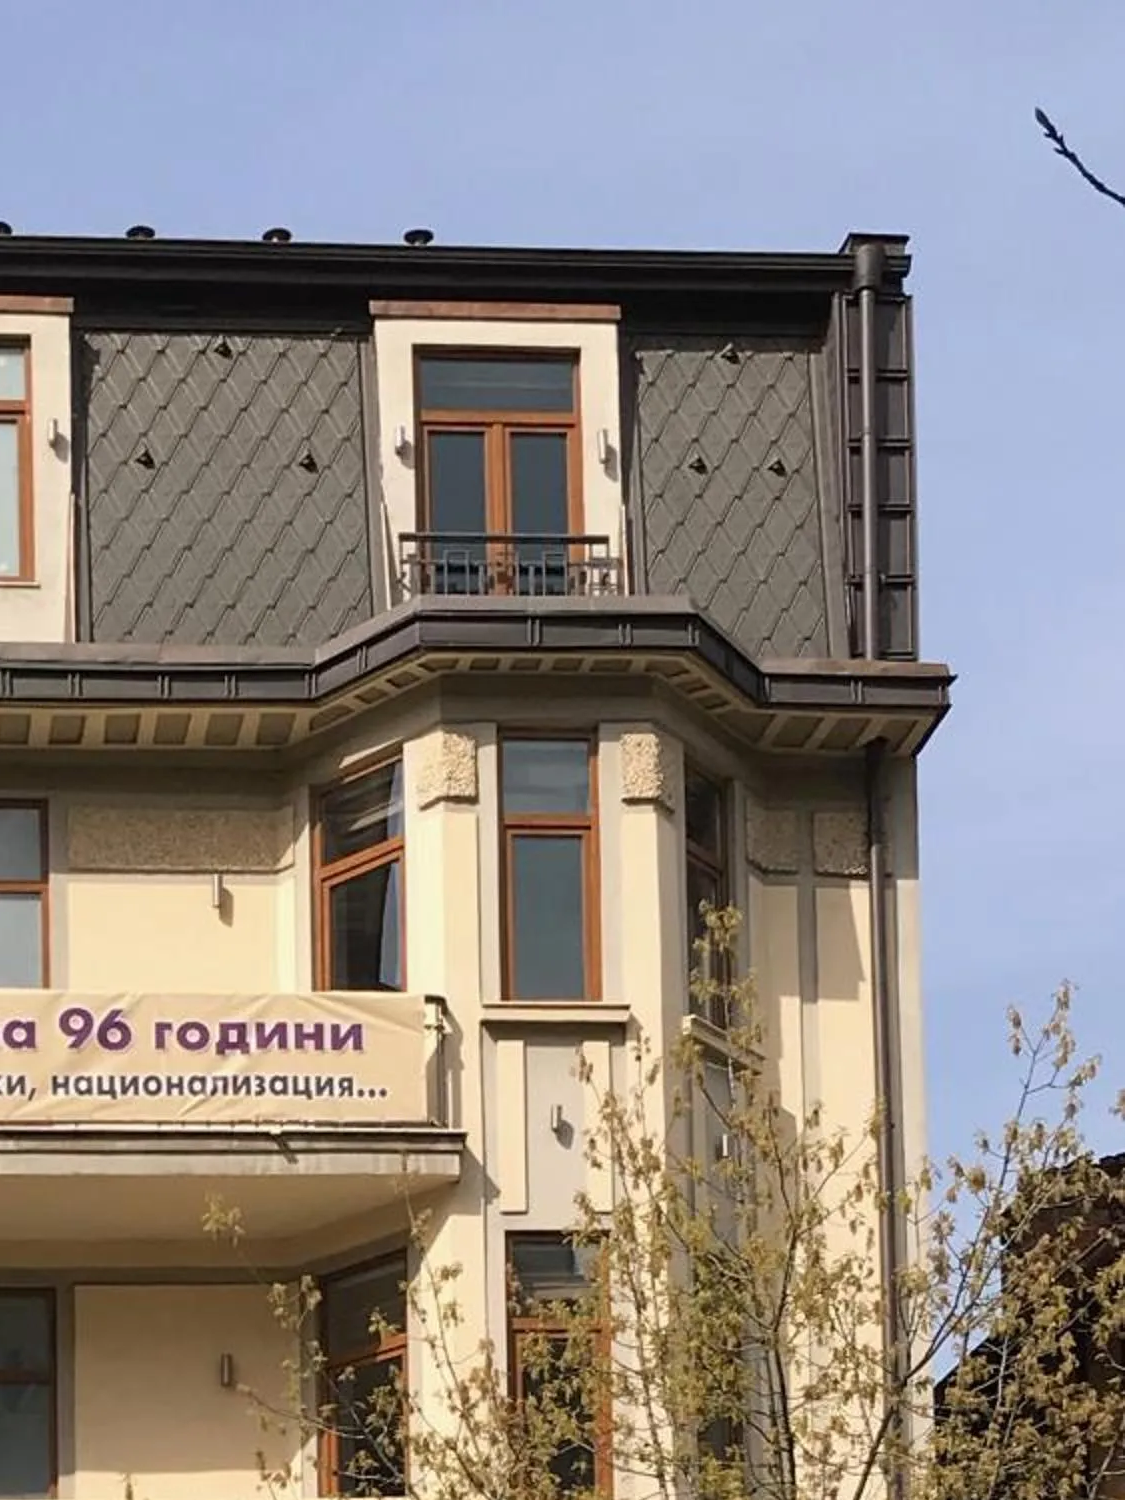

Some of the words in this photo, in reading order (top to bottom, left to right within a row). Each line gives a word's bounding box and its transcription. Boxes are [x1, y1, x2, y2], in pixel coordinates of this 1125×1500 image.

[58, 1007, 133, 1051] 96
[154, 1020, 365, 1055] години
[51, 1072, 388, 1099] национализация...
